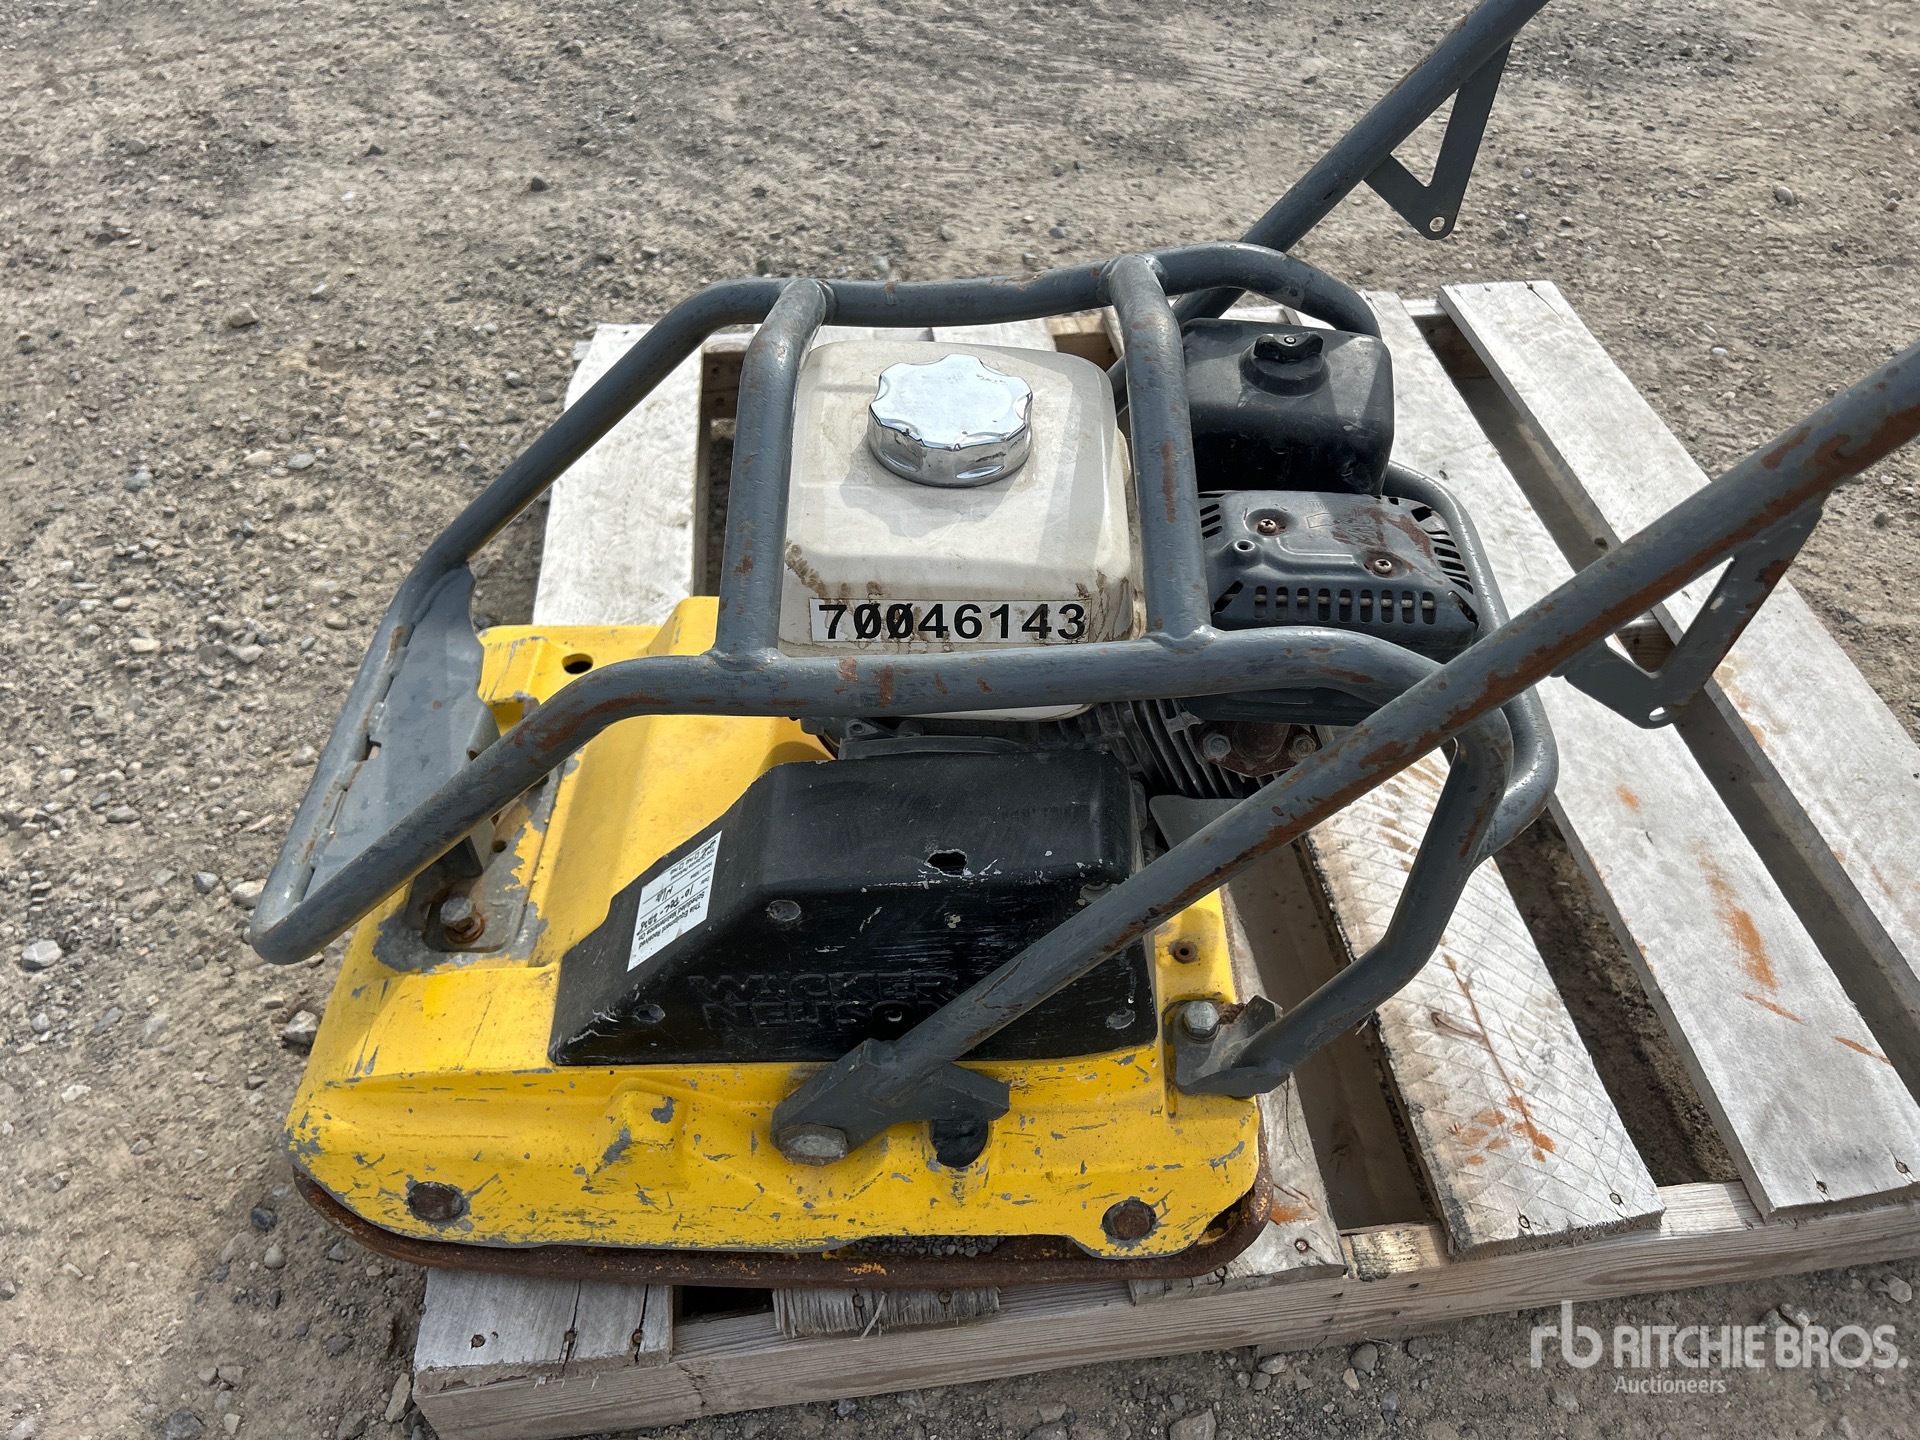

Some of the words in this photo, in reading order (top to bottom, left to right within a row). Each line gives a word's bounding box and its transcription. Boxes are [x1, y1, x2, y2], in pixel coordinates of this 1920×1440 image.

[818, 603, 1086, 639] 70046143
[677, 891, 705, 913] Scheduled
[689, 901, 701, 913] This
[647, 911, 676, 935] Maintenance
[661, 910, 688, 933] Equipment
[638, 932, 645, 941] On
[639, 930, 660, 949] Received
[687, 972, 960, 1003] WACKER
